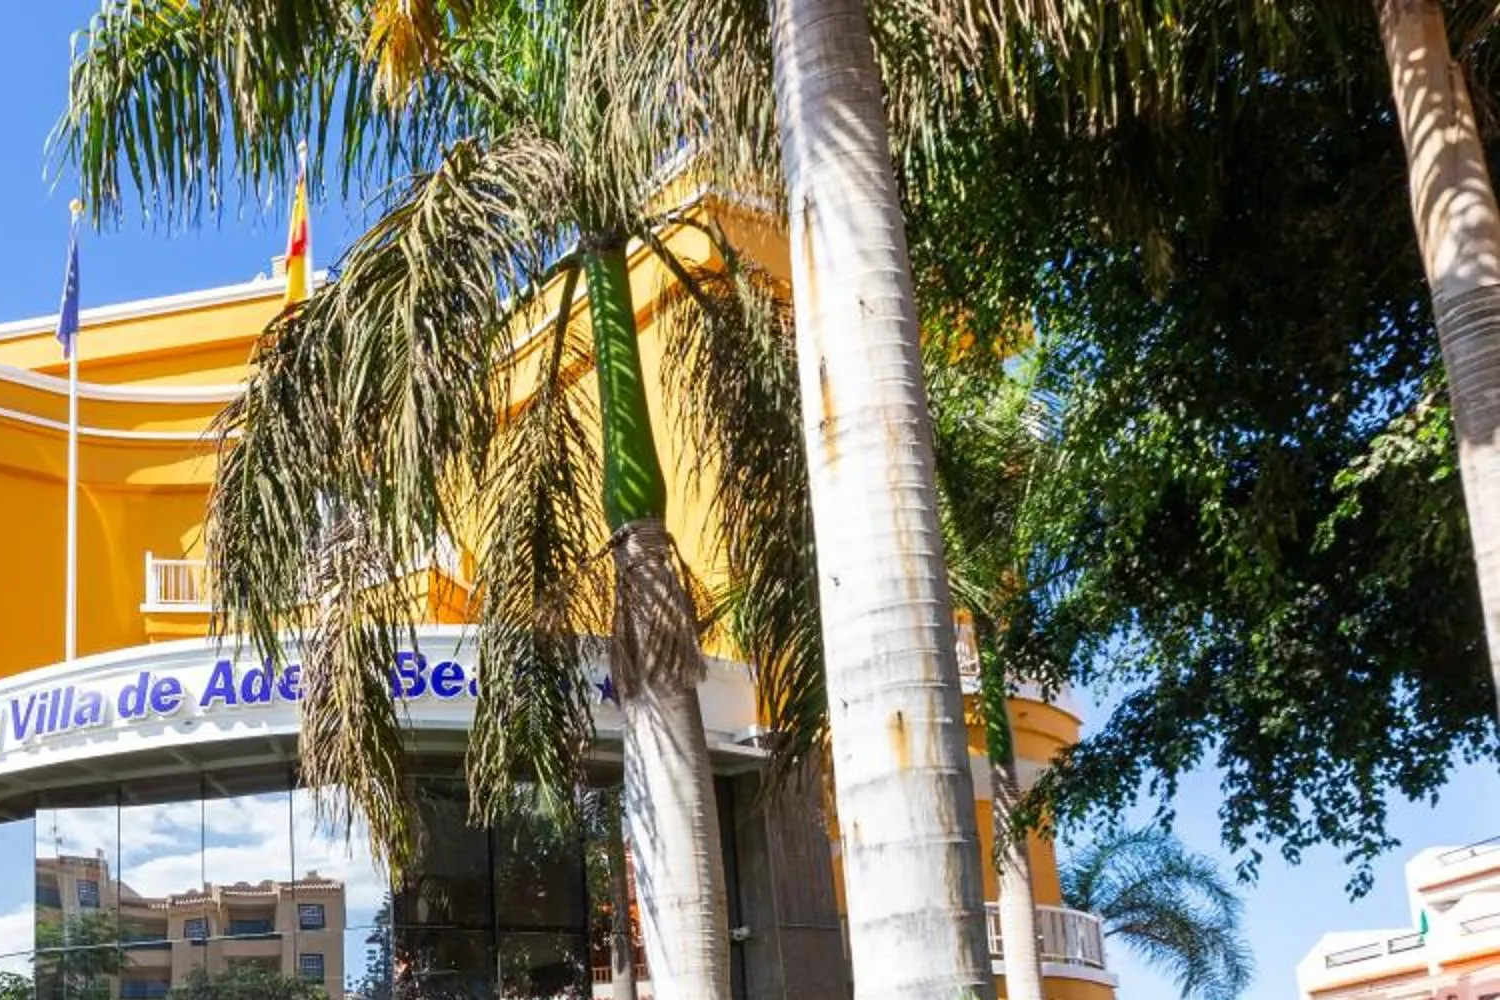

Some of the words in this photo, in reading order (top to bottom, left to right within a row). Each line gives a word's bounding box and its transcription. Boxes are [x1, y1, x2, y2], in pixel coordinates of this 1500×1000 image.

[11, 685, 102, 741] Villa
[117, 670, 184, 719] de
[200, 655, 348, 708] Ade
